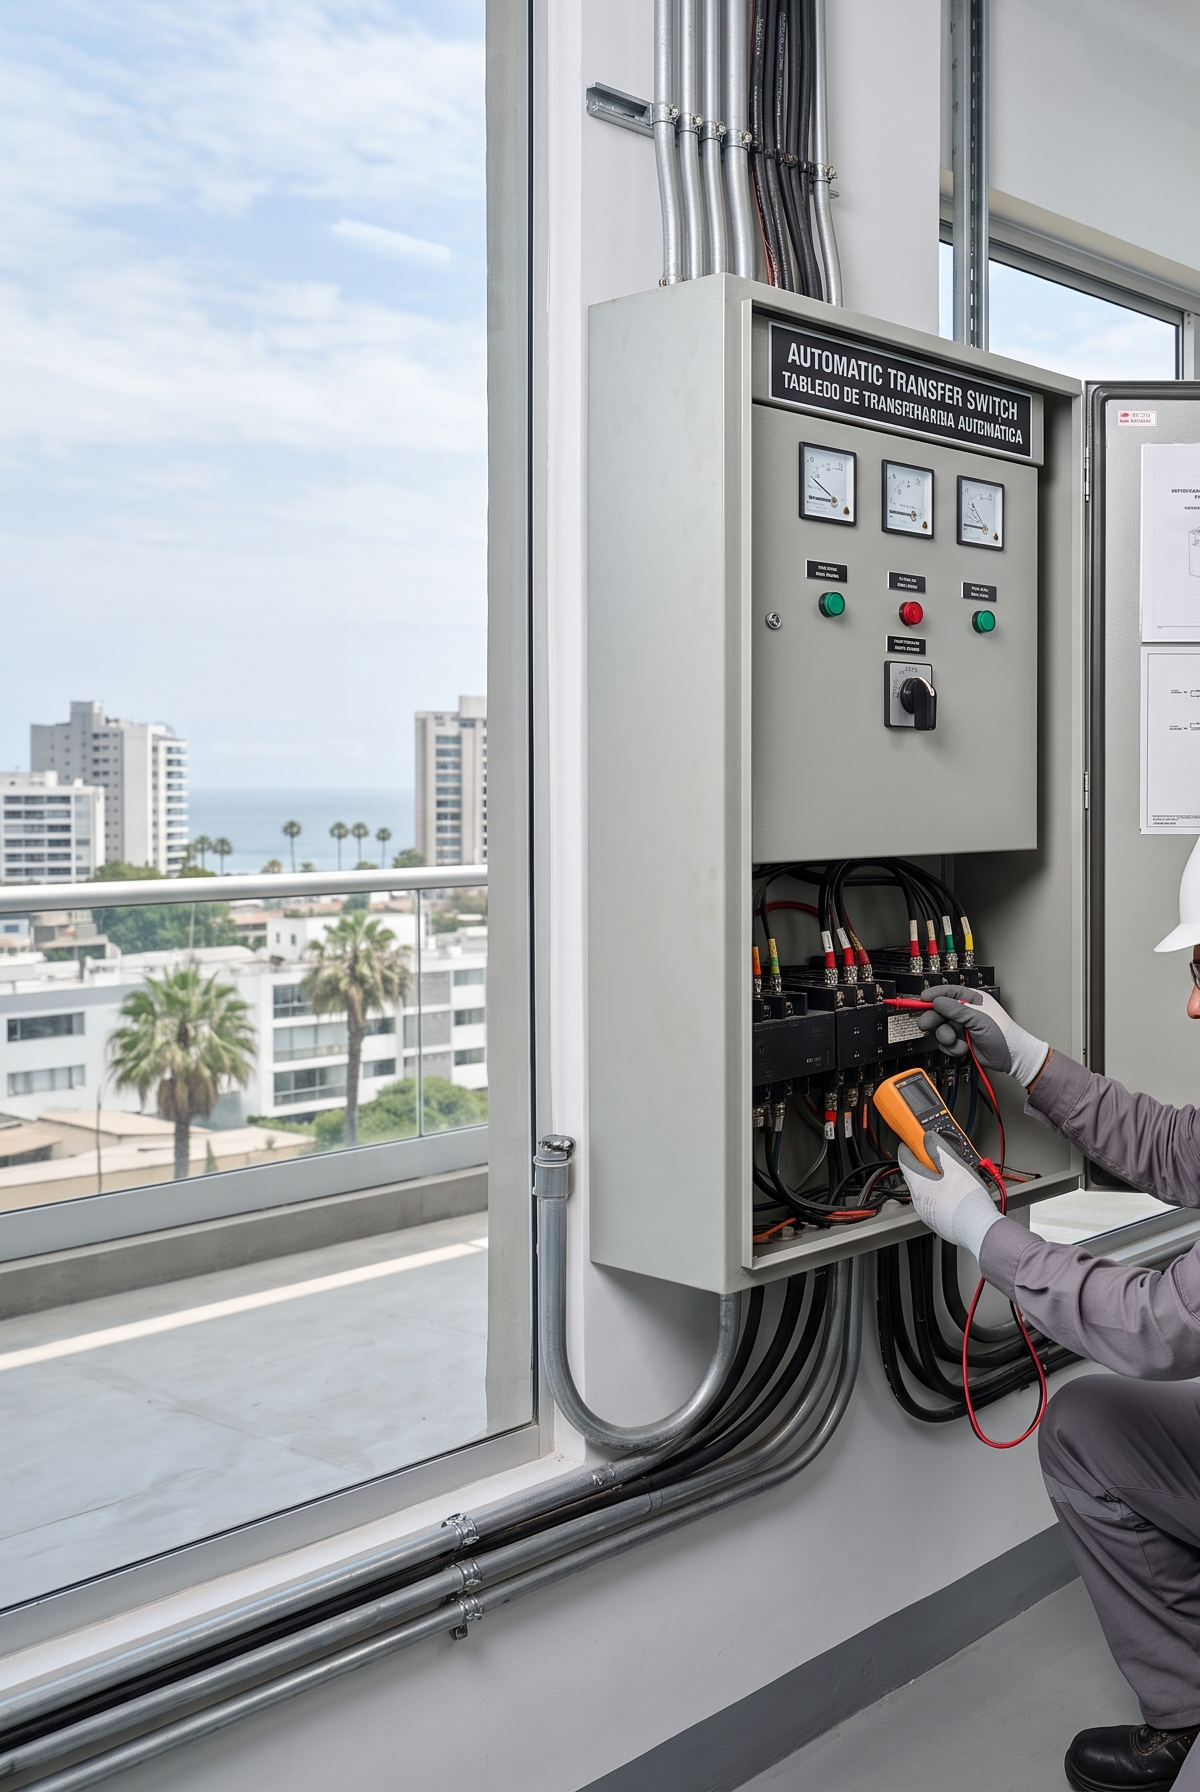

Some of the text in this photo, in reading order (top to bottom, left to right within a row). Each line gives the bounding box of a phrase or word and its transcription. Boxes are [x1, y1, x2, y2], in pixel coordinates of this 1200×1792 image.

[782, 371, 840, 400] TABLEDO
[843, 386, 860, 405] DE
[787, 342, 1018, 421] AUTOMATIC TRANSFER SWITCH
